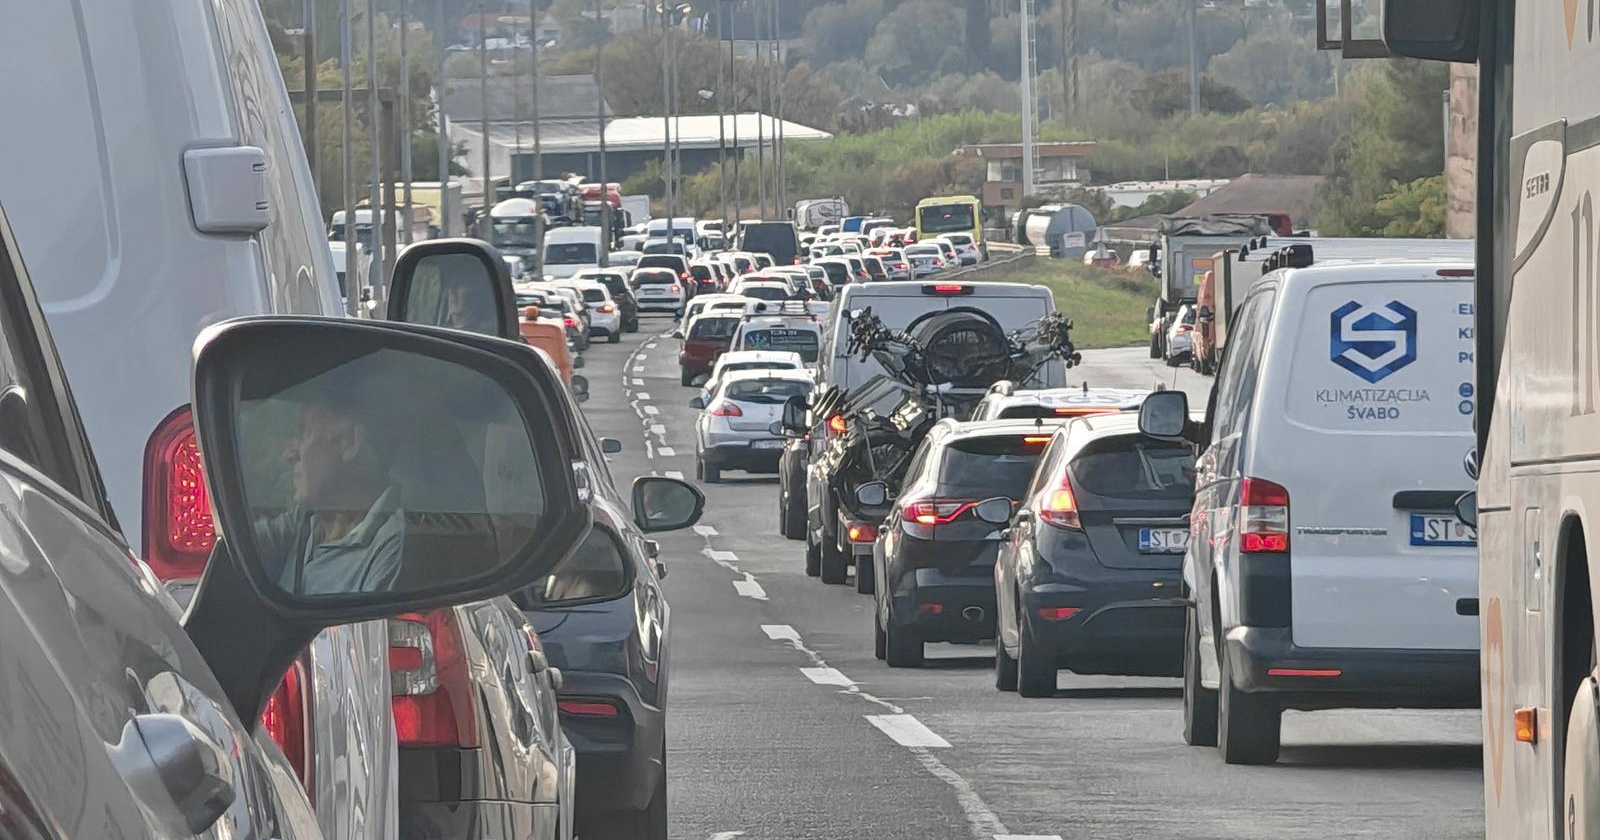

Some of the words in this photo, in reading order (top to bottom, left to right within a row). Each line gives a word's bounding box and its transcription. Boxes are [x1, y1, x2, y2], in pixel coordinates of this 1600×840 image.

[1316, 389, 1431, 403] KLIMATIZACIJA
[1347, 406, 1400, 420] ŠVABO
[1427, 519, 1452, 541] ST
[1152, 531, 1171, 547] ST
